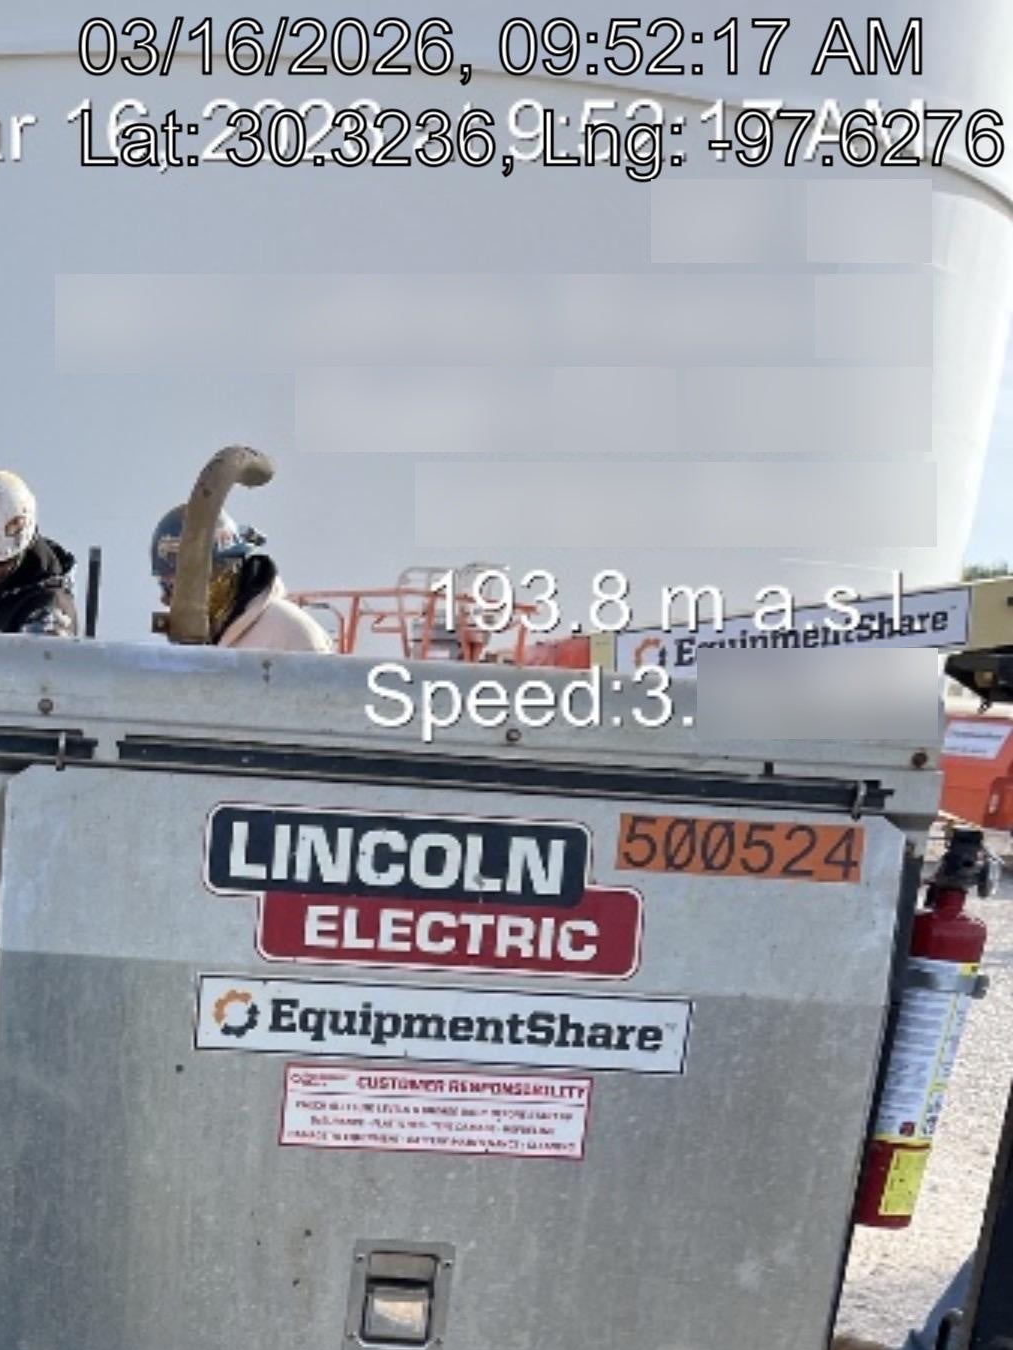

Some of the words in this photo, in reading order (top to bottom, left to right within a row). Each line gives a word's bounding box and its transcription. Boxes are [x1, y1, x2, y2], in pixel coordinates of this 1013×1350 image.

[674, 609, 949, 666] EimenShare
[228, 819, 567, 896] LINCOLN
[622, 815, 860, 880] 500524
[303, 904, 600, 963] ELECTRIC
[268, 997, 665, 1055] EquipmentShare
